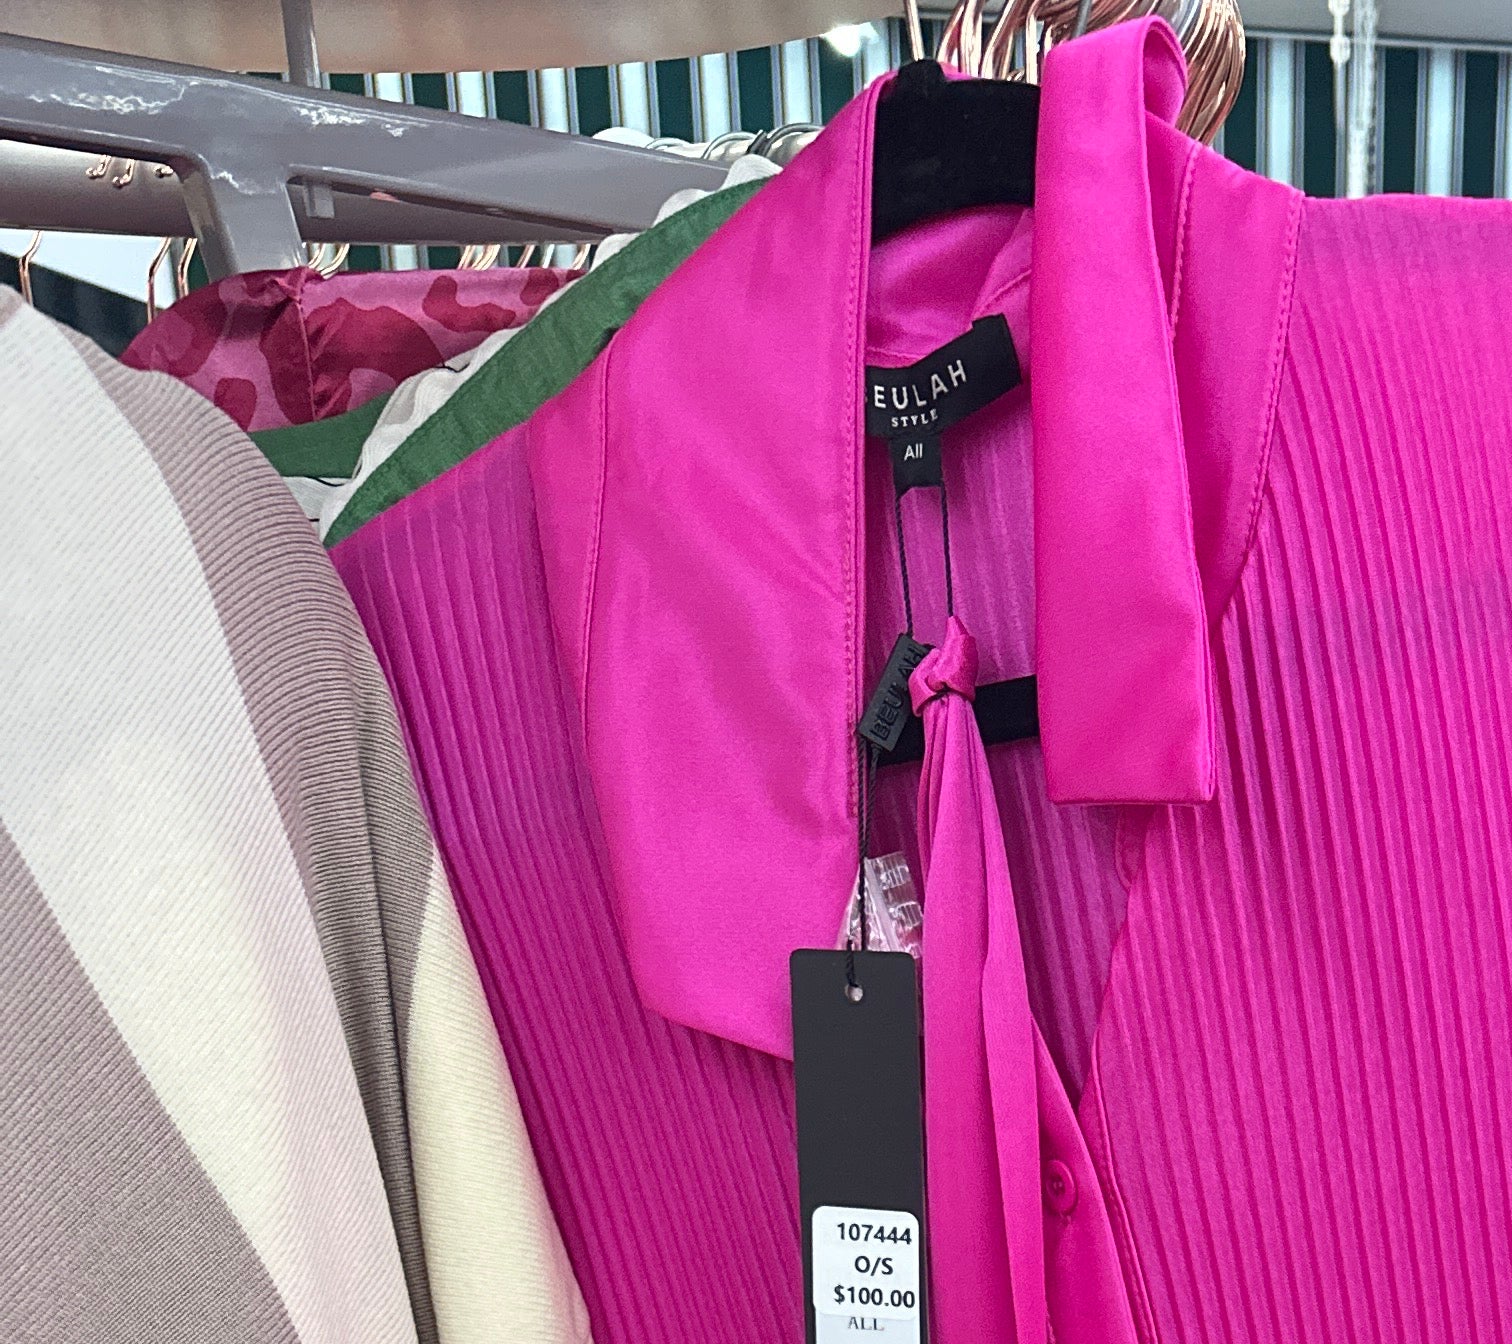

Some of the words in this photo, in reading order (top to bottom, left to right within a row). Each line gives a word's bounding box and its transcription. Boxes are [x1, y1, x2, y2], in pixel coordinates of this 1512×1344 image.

[868, 359, 968, 410] EULAH
[891, 408, 939, 428] STYLE
[836, 1221, 913, 1246] 107444
[853, 1254, 895, 1277] O/S
[833, 1284, 916, 1309] $100.00
[847, 1316, 886, 1332] ALL
